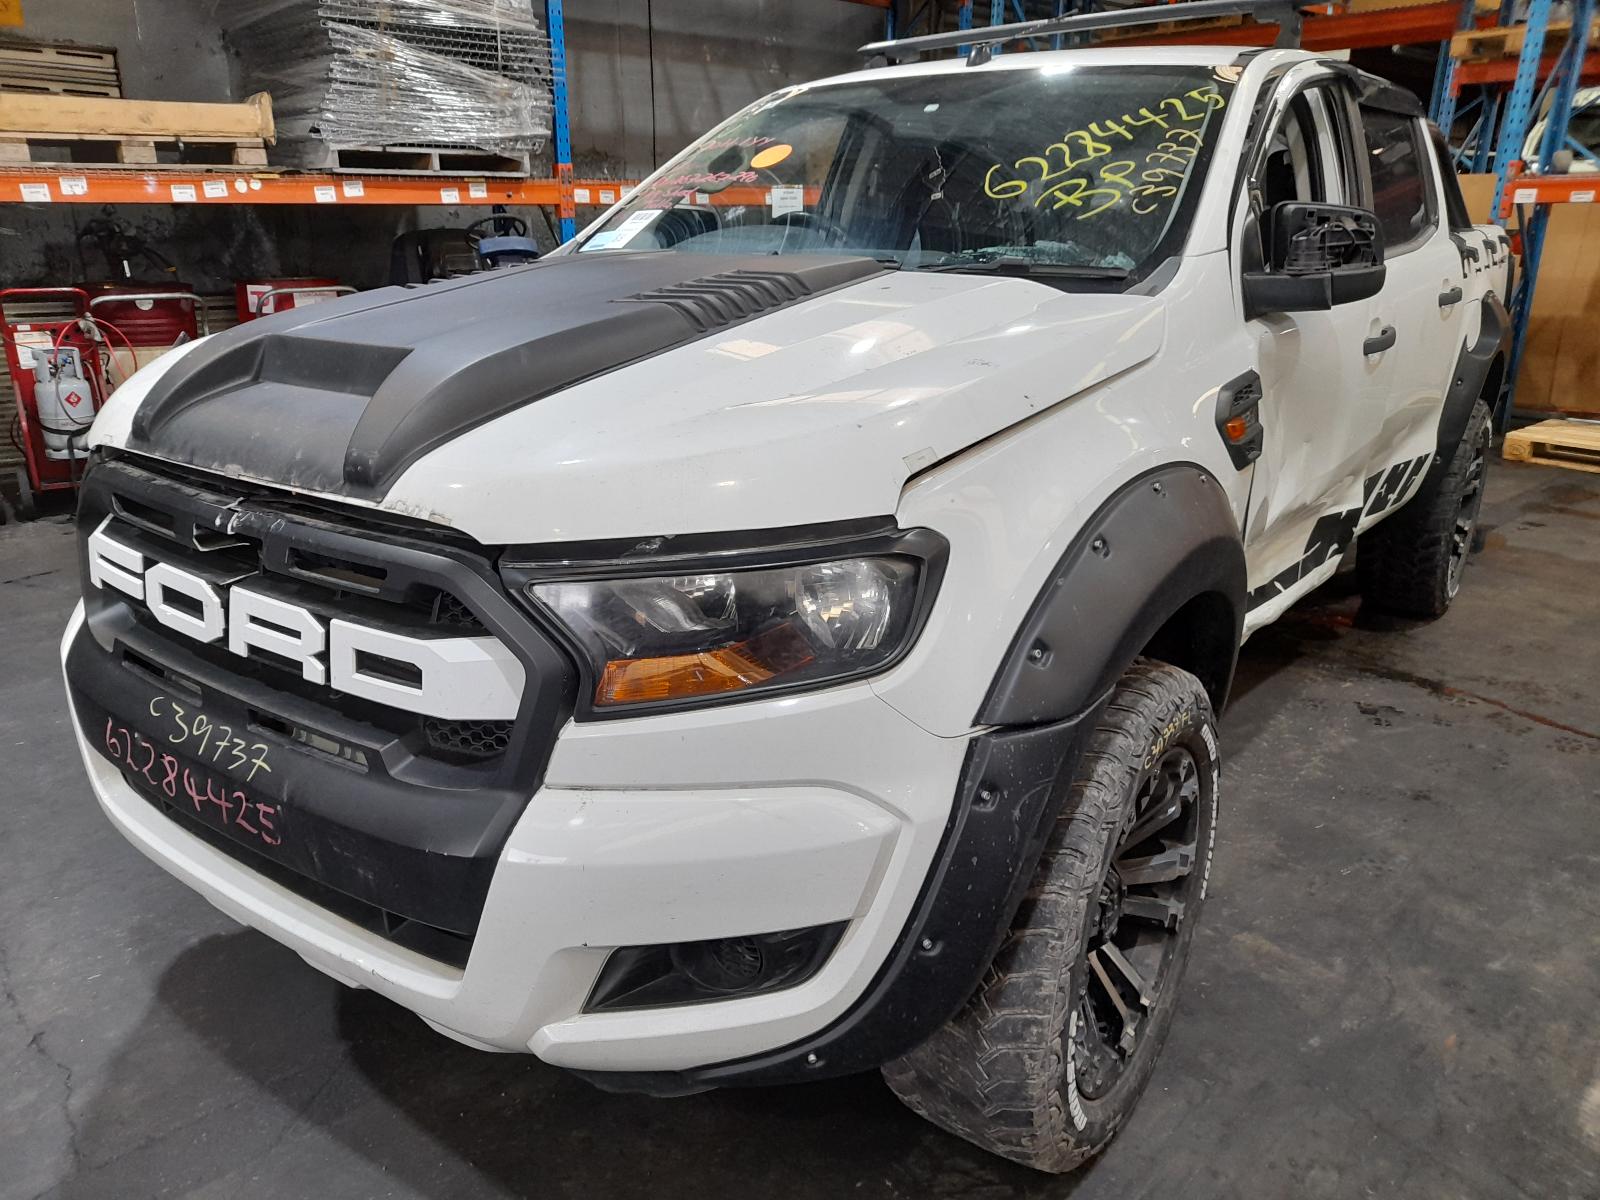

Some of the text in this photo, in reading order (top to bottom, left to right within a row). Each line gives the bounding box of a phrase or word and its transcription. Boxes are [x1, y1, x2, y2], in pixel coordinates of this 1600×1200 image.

[984, 86, 1225, 198] 62284425
[1129, 128, 1205, 214] C39737
[88, 513, 527, 720] FORD
[106, 717, 282, 845] 62284425
[150, 696, 272, 782] C39737
